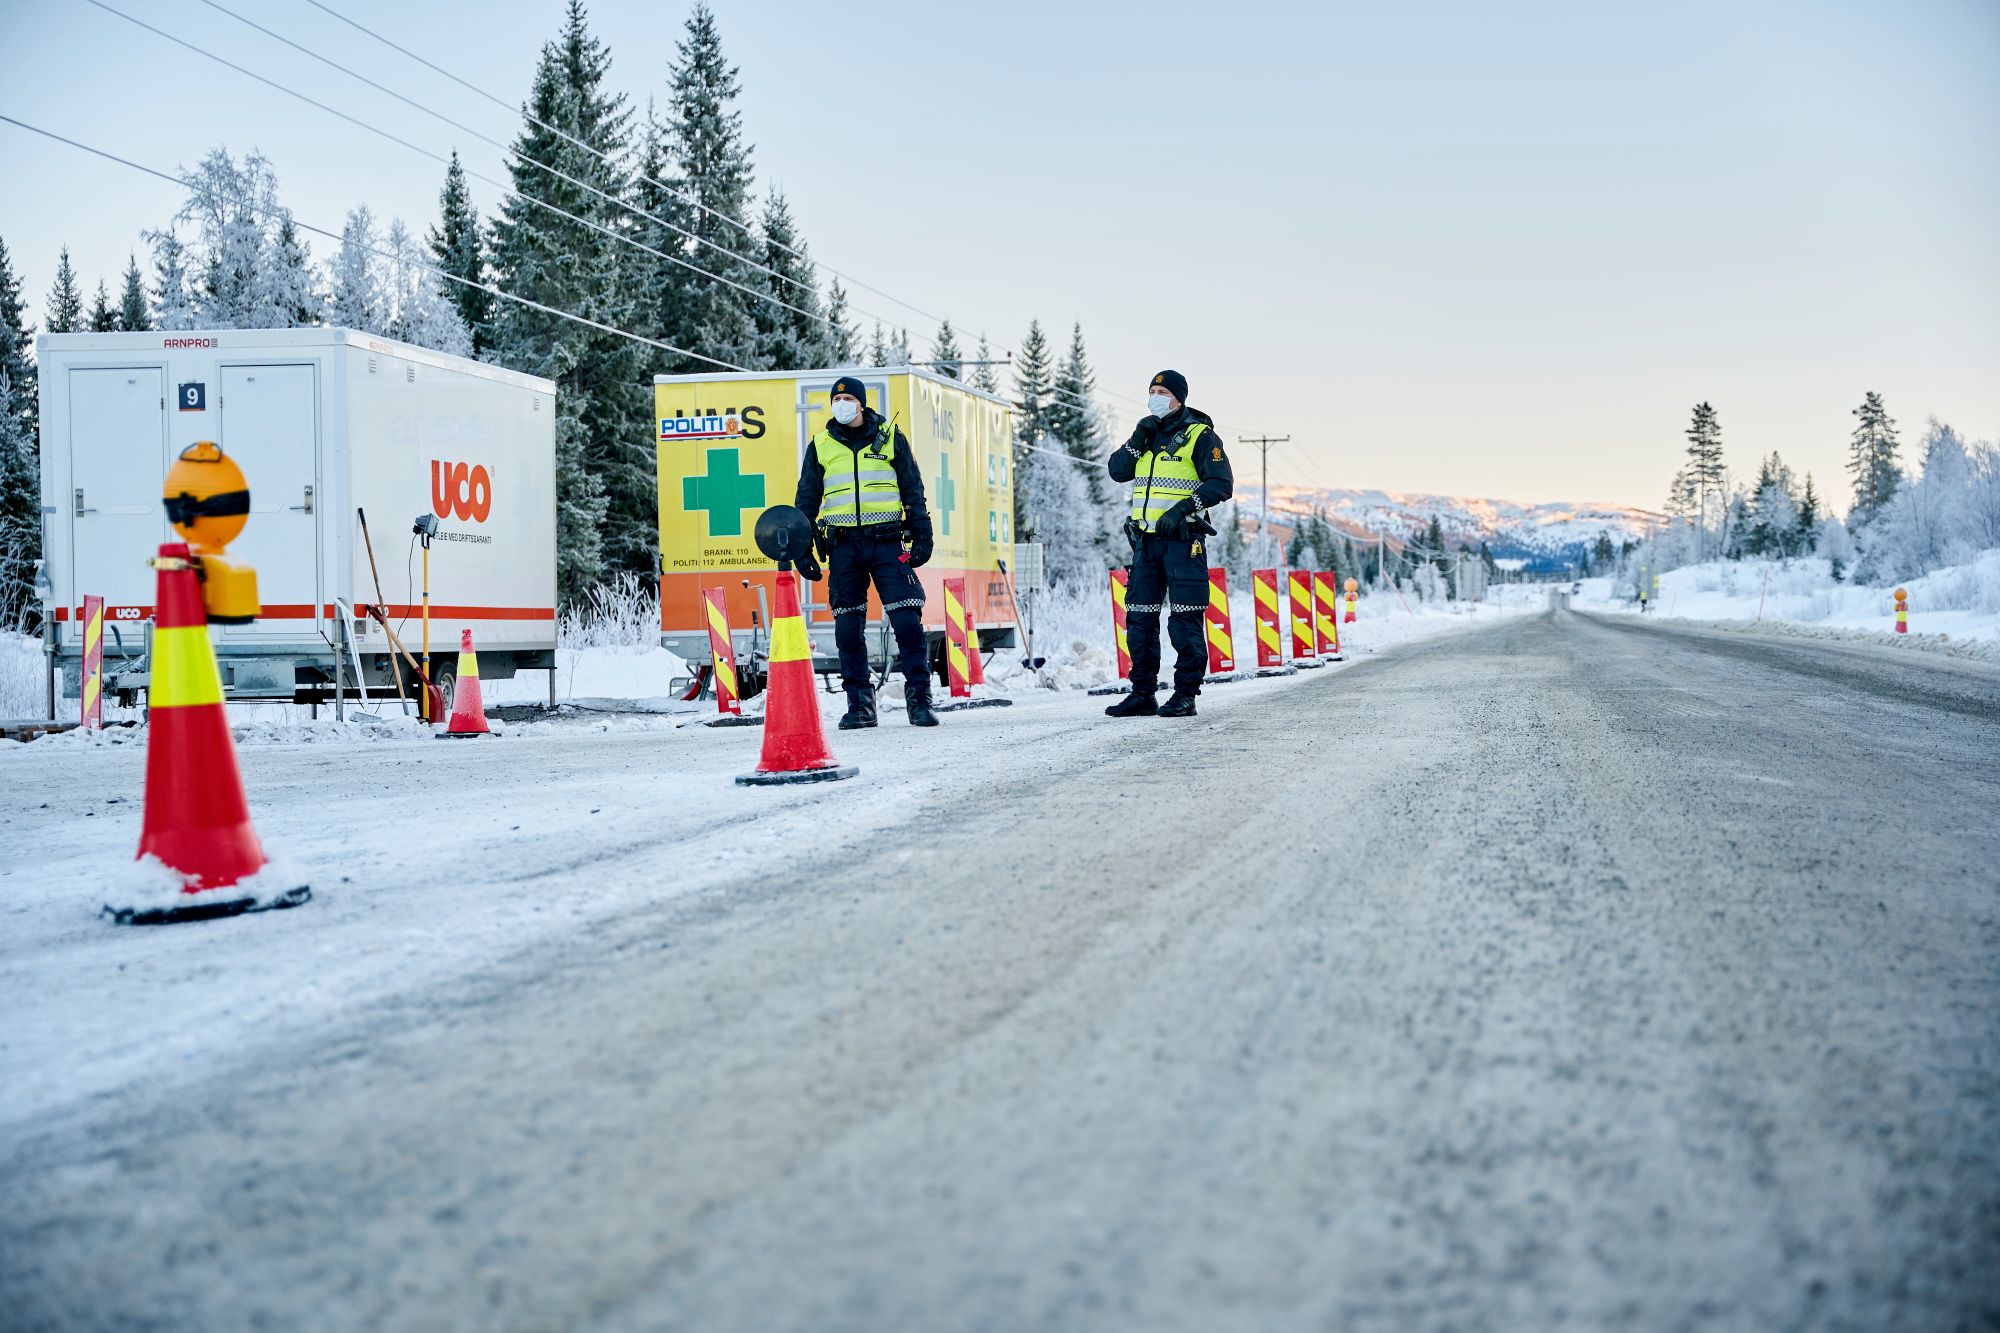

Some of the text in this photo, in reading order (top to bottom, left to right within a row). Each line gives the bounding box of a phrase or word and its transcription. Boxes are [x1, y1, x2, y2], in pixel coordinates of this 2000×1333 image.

[164, 338, 210, 348] ARNPRO
[186, 387, 199, 406] 9
[661, 416, 723, 434] POLITI
[431, 459, 492, 523] UCO
[704, 549, 734, 557] BRANN:
[673, 559, 700, 567] POLITI:
[719, 557, 771, 566] AMBULANSE:
[116, 607, 141, 619] UCO
